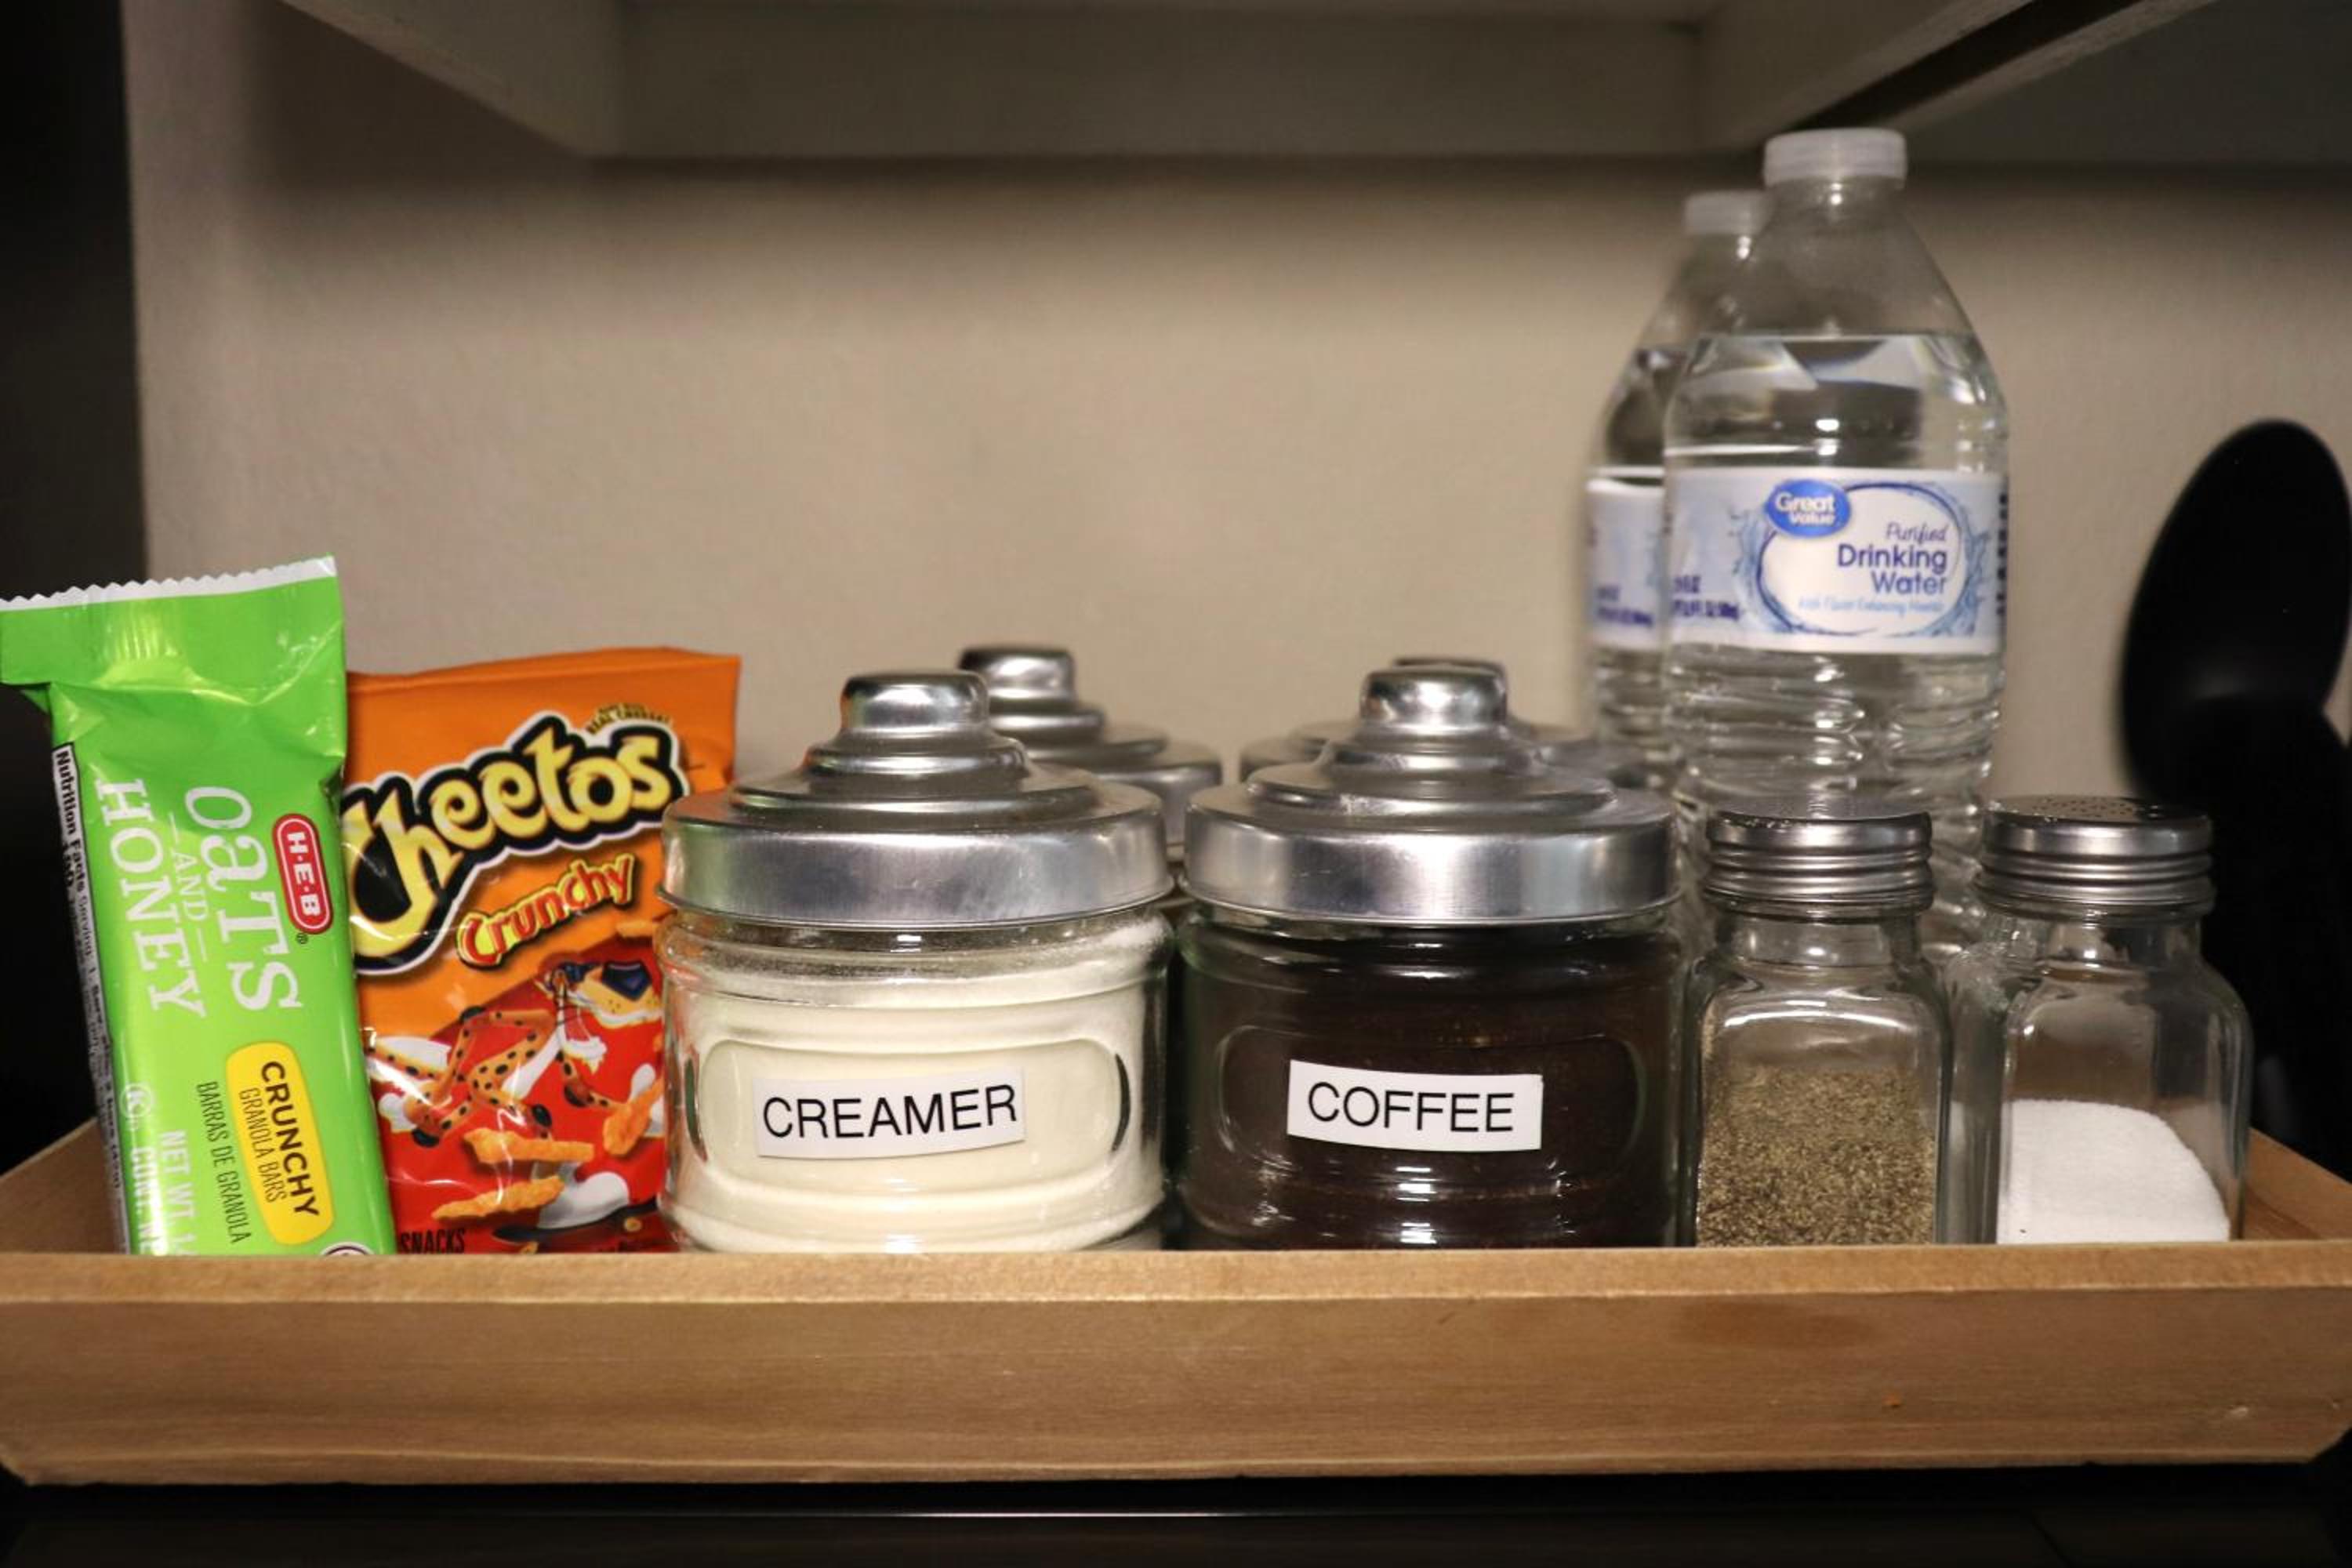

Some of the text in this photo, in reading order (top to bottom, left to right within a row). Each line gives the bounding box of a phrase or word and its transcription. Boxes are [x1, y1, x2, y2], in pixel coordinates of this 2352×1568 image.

[1776, 492, 1835, 513] Great
[1886, 522, 1947, 544] Purified
[1838, 543, 1947, 575] Drinking
[1871, 571, 1947, 594] Water
[55, 750, 77, 835] Nutrition
[342, 720, 674, 964] Cheetos
[95, 778, 206, 1018] HONEY
[173, 850, 209, 921] AND
[461, 855, 633, 964] Crunchy
[763, 1083, 1018, 1139] CREAMER
[1307, 1081, 1515, 1132] COFFEE
[159, 1130, 191, 1174] NET
[197, 1080, 252, 1244] BARRAS DE GRANOLA
[239, 1087, 287, 1203] GRANOLA BARS
[261, 1060, 320, 1217] CRUNCHY
[401, 1229, 465, 1254] SNACKS
